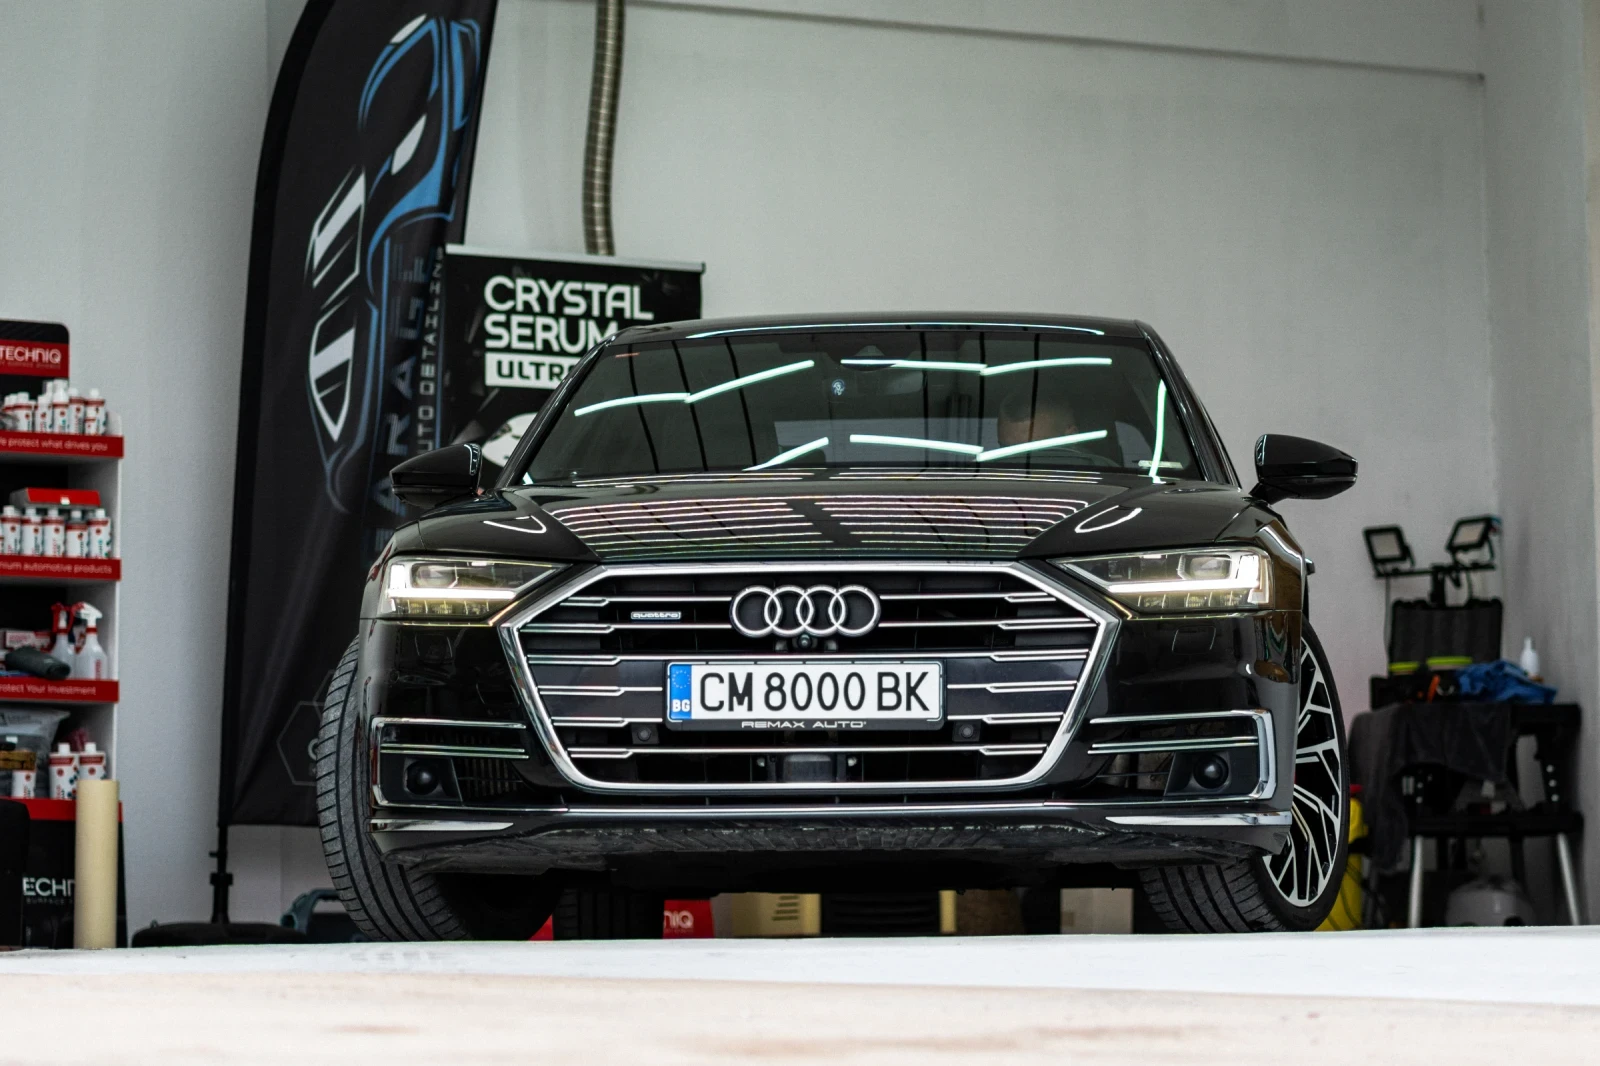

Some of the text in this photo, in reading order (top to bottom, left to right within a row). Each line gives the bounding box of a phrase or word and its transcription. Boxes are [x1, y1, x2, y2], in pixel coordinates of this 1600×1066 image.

[484, 275, 654, 320] CRYSTAL
[484, 313, 618, 354] SERUM
[497, 360, 576, 382] ULTR
[416, 405, 435, 455] UTO
[8, 438, 39, 448] protect
[41, 440, 62, 449] what
[64, 440, 90, 450] drives
[91, 442, 107, 452] you
[23, 563, 72, 573] automotive
[73, 564, 112, 574] products
[26, 684, 45, 693] Your
[700, 671, 929, 712] CM 8000 BK
[672, 699, 691, 712] BG
[741, 721, 863, 729] REMAX AUTO
